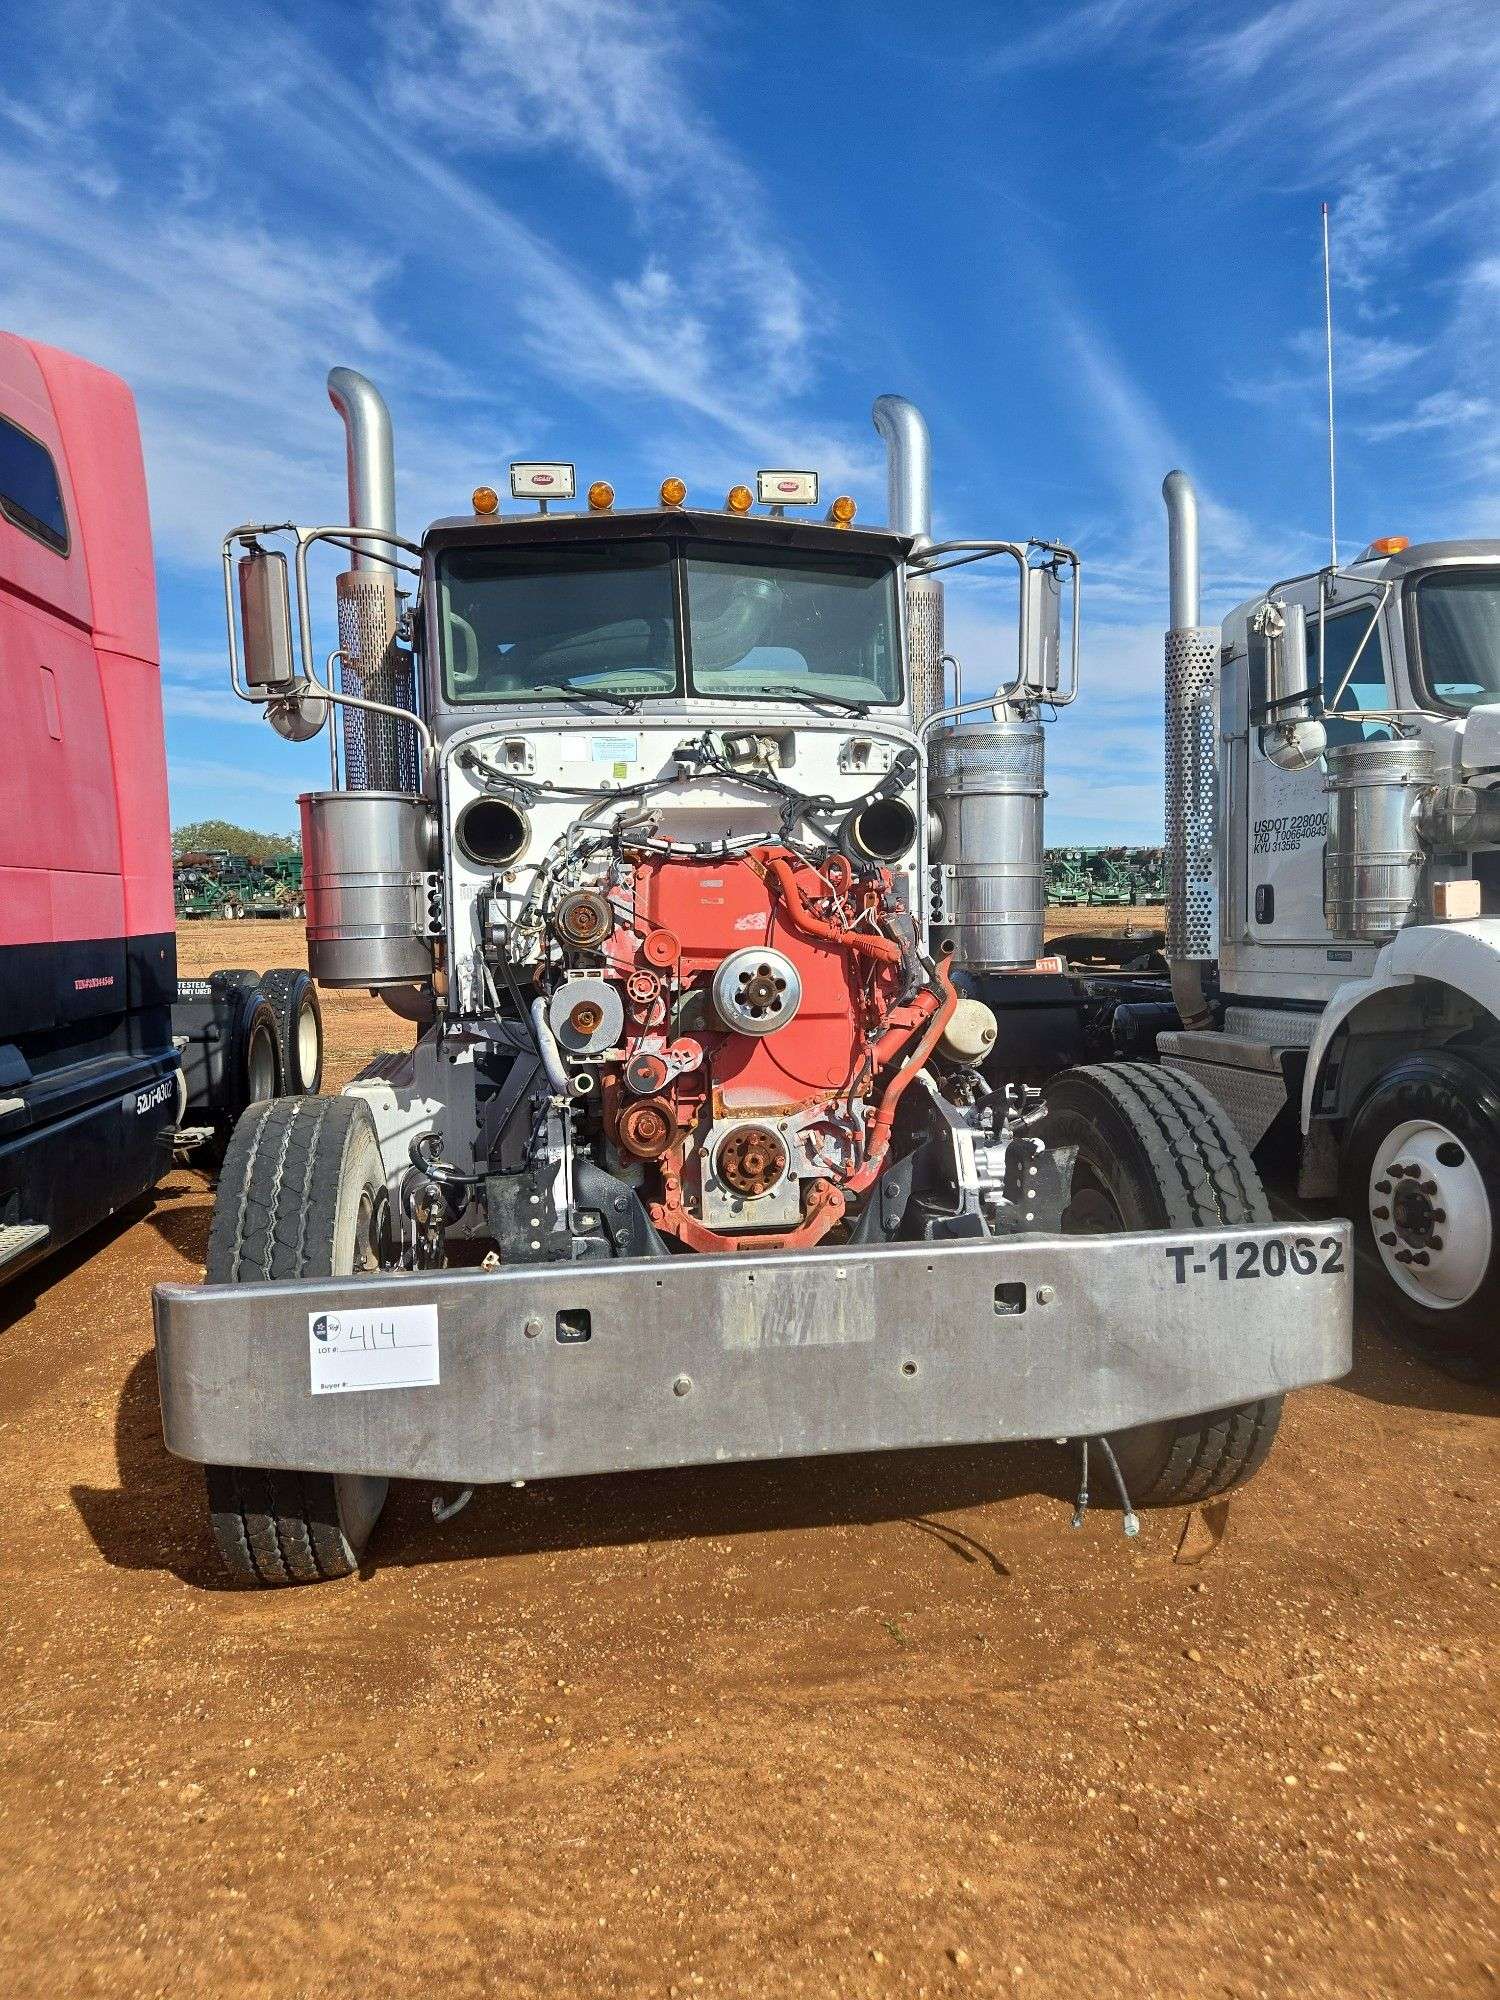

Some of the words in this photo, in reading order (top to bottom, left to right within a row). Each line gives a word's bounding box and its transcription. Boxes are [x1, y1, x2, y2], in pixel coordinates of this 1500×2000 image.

[1254, 818, 1289, 834] USDOT
[1254, 841, 1271, 854] KYU
[1165, 1236, 1345, 1284] T-12062
[349, 1322, 396, 1350] 414
[318, 1346, 331, 1354] LOT
